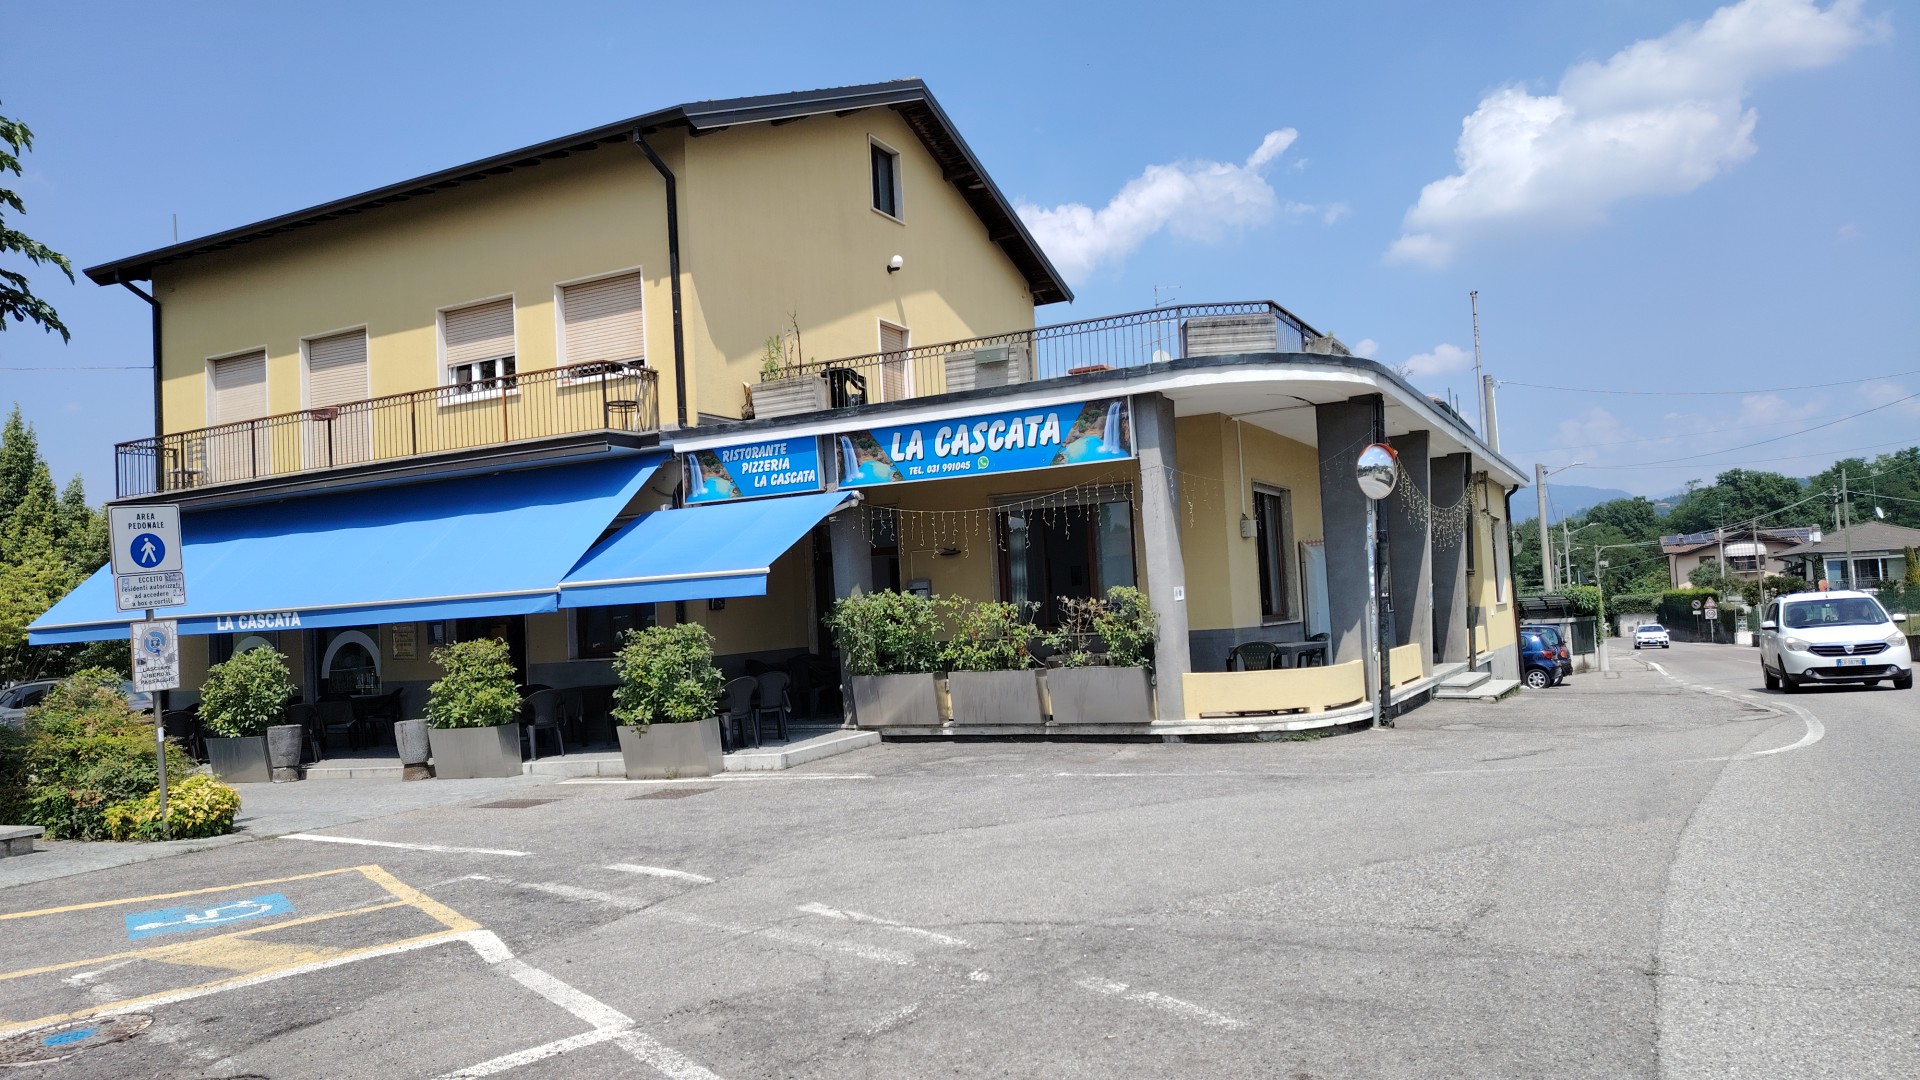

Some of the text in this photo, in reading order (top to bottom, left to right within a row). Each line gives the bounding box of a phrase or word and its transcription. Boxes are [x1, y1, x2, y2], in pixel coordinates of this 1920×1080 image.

[890, 412, 1062, 463] LA CASCATA
[722, 442, 788, 463] RISTORANTE
[741, 457, 791, 475] PIZZERIA
[908, 461, 971, 476] TEL. 031 991045
[754, 469, 816, 488] LA CASCATA
[136, 512, 156, 521] AREA
[128, 521, 165, 530] PEDONALE
[138, 575, 163, 583] ECCETTO
[121, 582, 181, 593] residenti autorizzati
[143, 590, 169, 598] accedere
[154, 597, 173, 605] cortili
[216, 611, 302, 631] LA CASCATA
[142, 665, 172, 673] LASCIARE
[140, 677, 175, 685] PASSAGGIO
